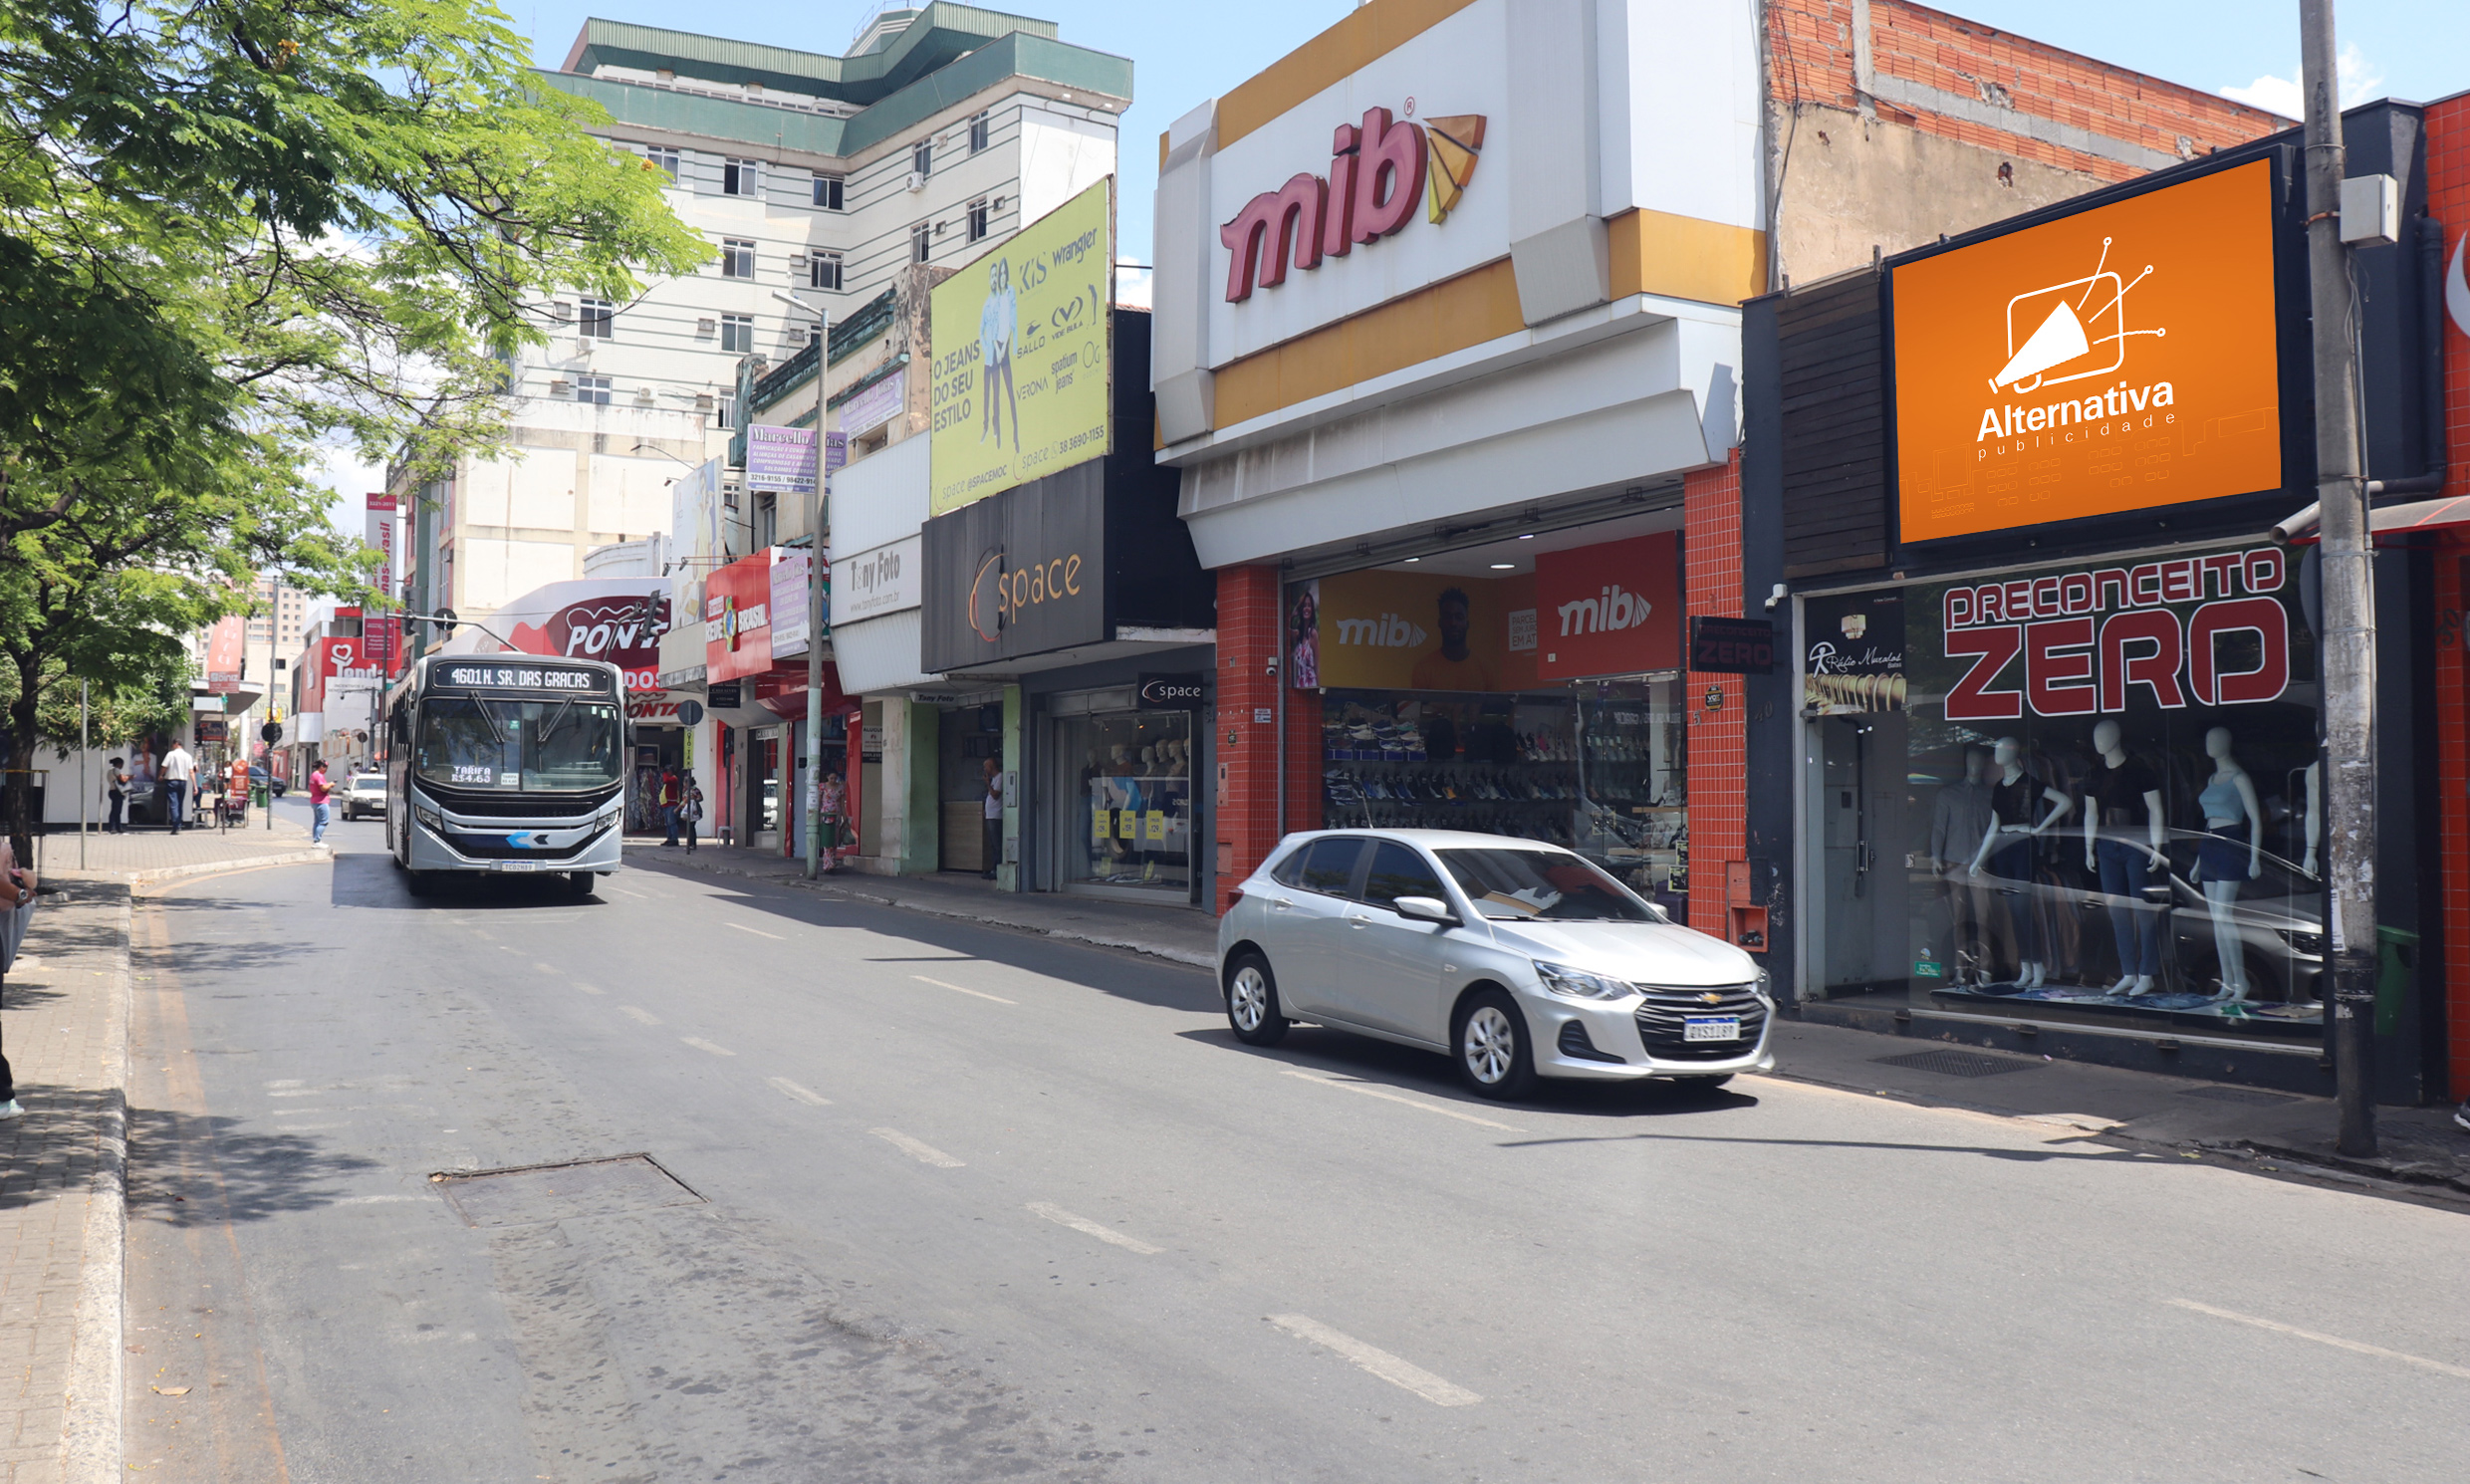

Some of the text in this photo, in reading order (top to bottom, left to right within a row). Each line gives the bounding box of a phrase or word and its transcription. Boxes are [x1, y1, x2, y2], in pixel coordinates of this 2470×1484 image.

[1220, 106, 1428, 304] mib
[1052, 228, 1098, 269] Wrangler
[933, 340, 980, 379] O JEANS
[1017, 336, 1045, 359] SALLO
[933, 371, 973, 407] DO SEU
[933, 399, 971, 433] ESTILO
[1976, 379, 2175, 442] Alternativa
[752, 427, 845, 448] Marcello Jias
[1978, 411, 2176, 462] publicidade
[877, 550, 900, 589] Foto
[998, 552, 1082, 623] space
[1943, 546, 2286, 629] PRECONCEITO
[1558, 584, 1634, 637] mib
[1336, 613, 1415, 648] mib
[1697, 639, 1772, 666] ZERO
[1944, 596, 2290, 722] ZERO
[451, 668, 482, 684] 4601
[497, 669, 516, 686] SR.
[519, 670, 542, 687] DAS
[545, 671, 591, 688] GRACAS
[1158, 682, 1201, 699] space
[918, 694, 936, 703] Tony
[453, 766, 491, 775] TARIFA
